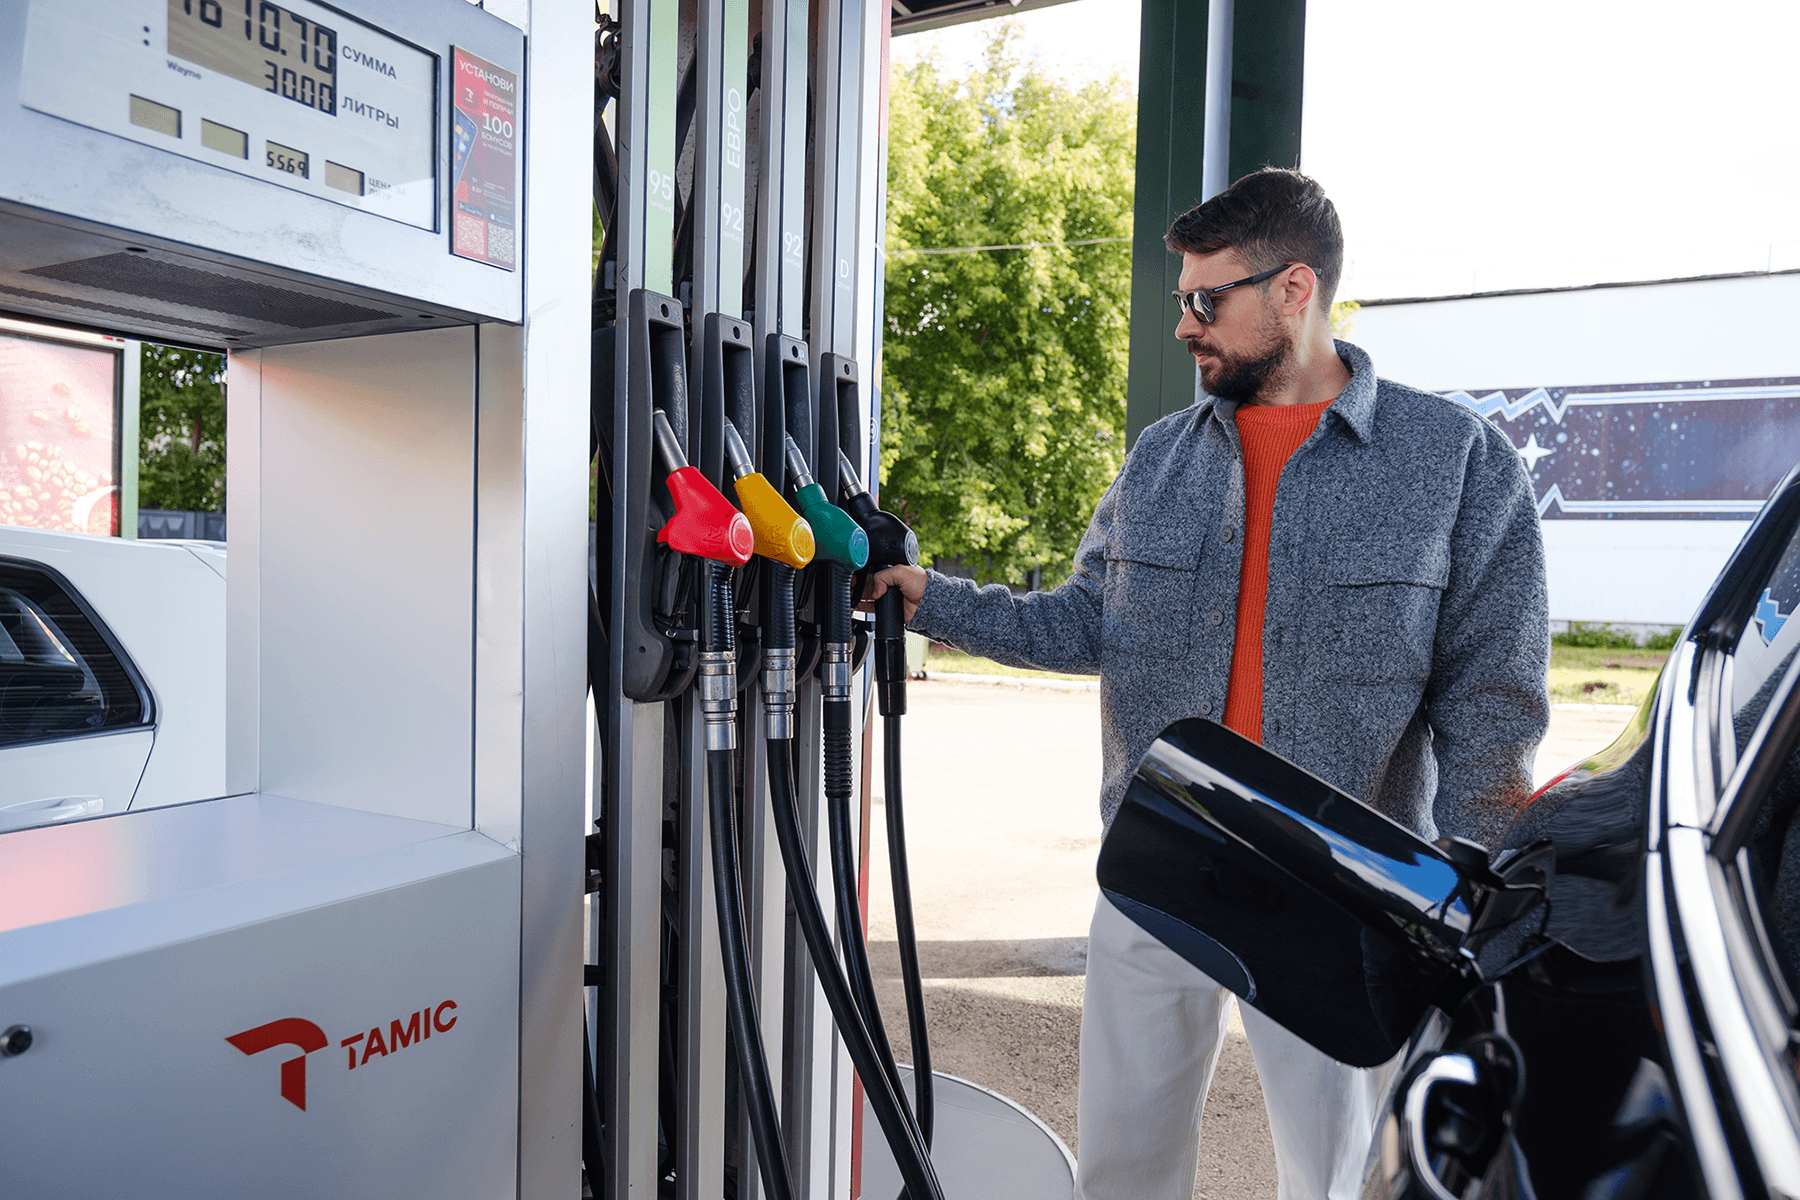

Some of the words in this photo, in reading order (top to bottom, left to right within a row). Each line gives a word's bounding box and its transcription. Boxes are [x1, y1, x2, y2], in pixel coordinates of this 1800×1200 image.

[342, 45, 397, 79] СУММА
[459, 59, 514, 93] УСТАНОВИ
[341, 96, 399, 129] ЛИТРЫ
[482, 113, 513, 138] 100
[727, 87, 741, 169] ЕВРО
[481, 131, 513, 150] БОНУСОВ
[649, 169, 672, 201] 95
[722, 202, 742, 232] 92
[784, 231, 801, 258] 92
[840, 258, 850, 279] D
[340, 999, 458, 1071] TAMIC
